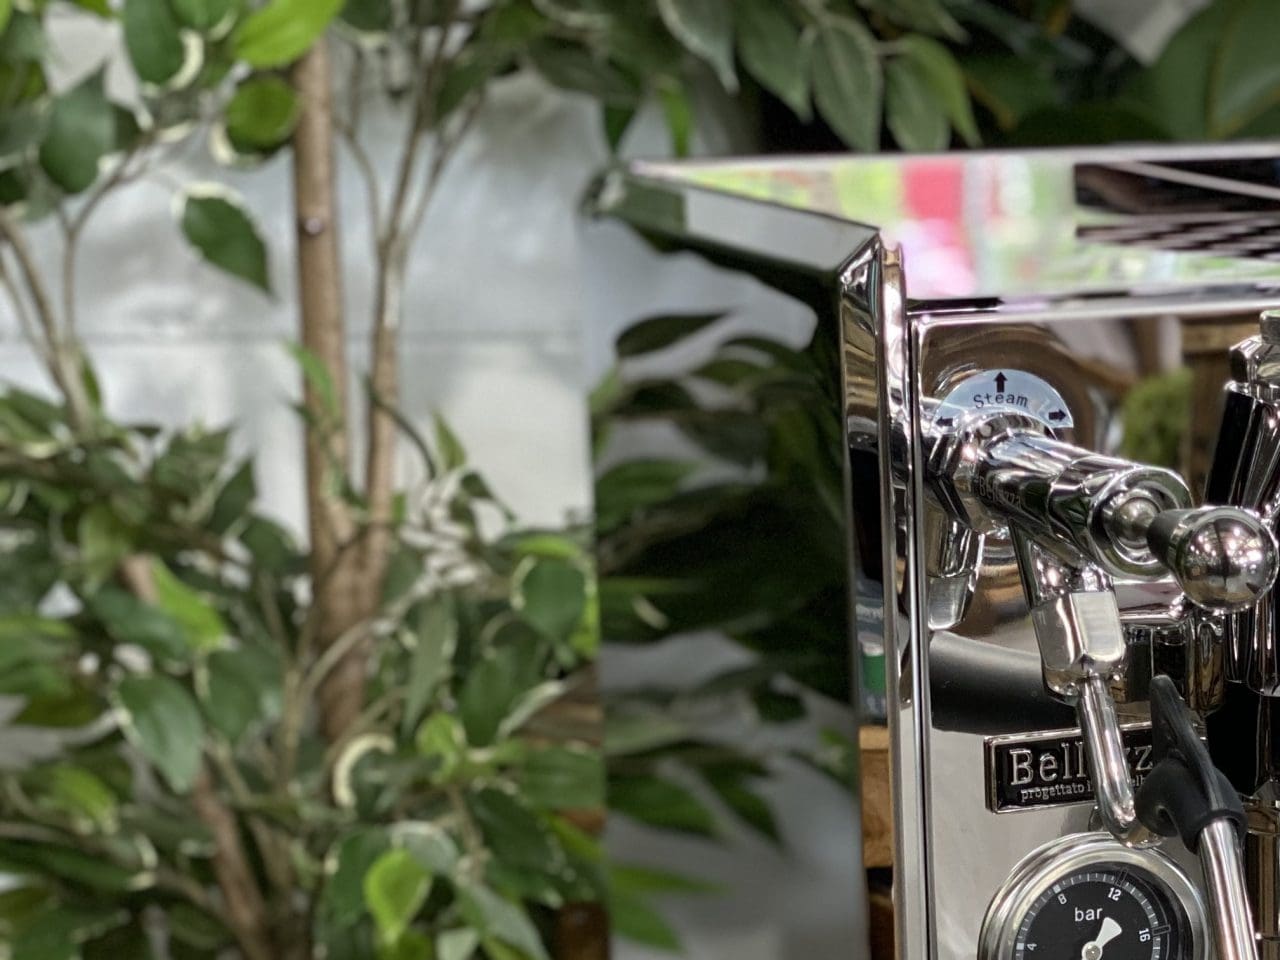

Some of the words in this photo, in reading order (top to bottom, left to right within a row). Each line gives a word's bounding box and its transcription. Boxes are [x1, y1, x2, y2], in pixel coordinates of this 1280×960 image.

[973, 393, 1029, 409] Steam
[1020, 782, 1084, 801] progettato
[1107, 887, 1122, 901] 12
[1074, 907, 1103, 922] bar
[1138, 928, 1150, 942] 16
[1026, 942, 1037, 951] 4
